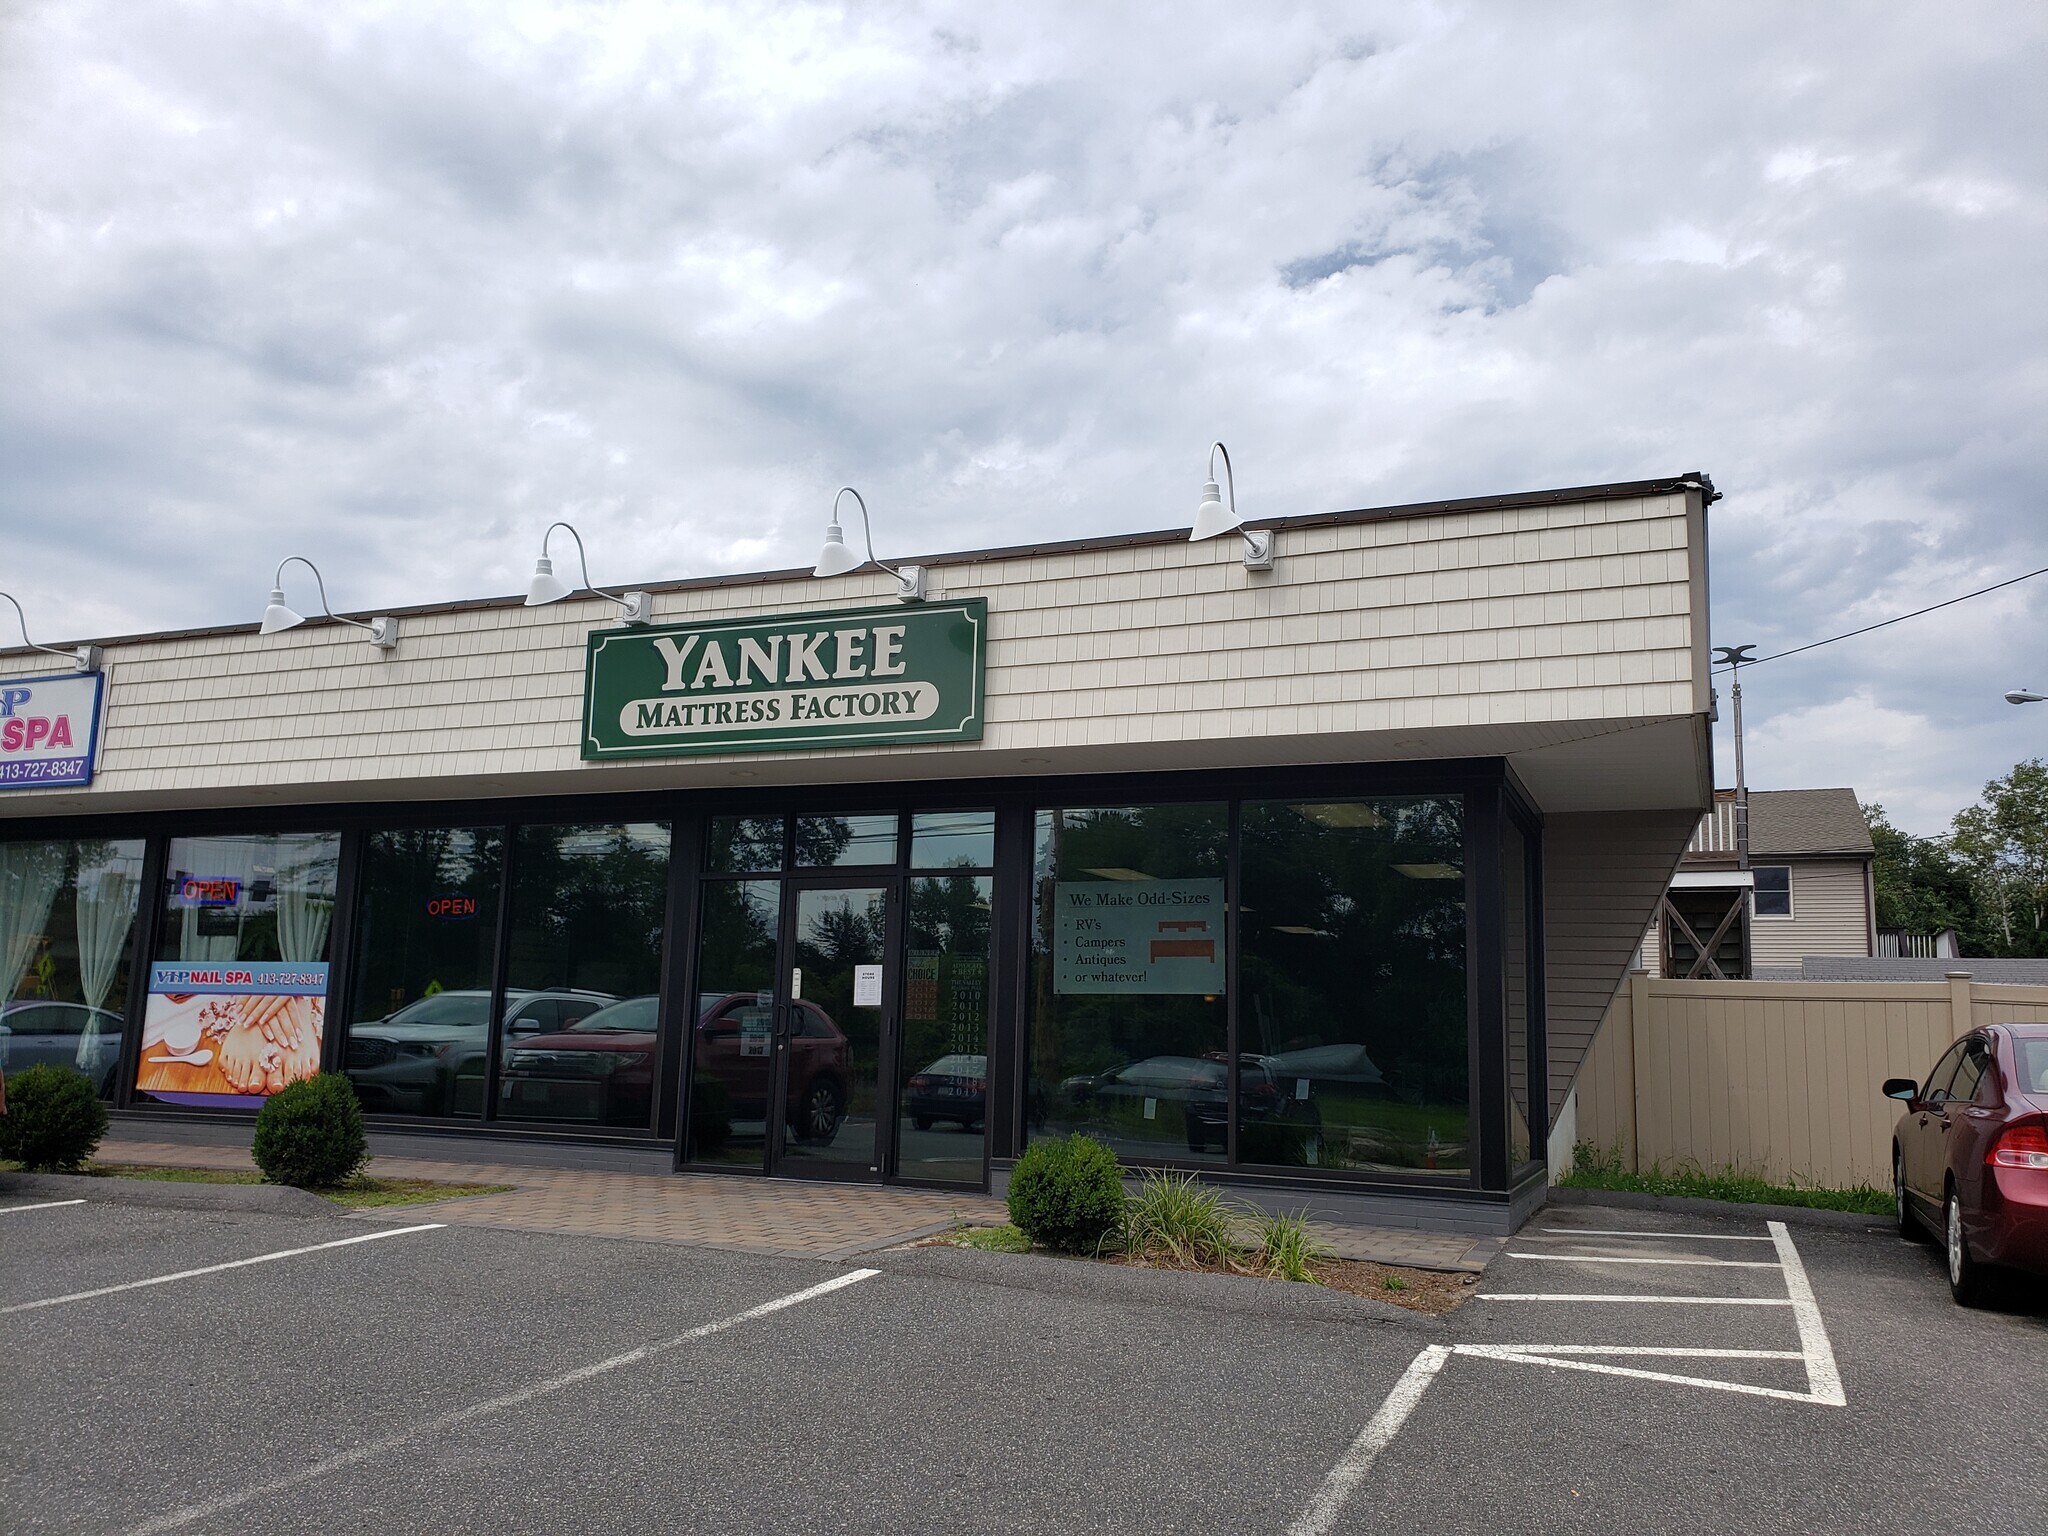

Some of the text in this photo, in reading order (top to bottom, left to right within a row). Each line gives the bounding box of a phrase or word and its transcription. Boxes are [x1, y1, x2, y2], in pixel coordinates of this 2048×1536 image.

[653, 625, 907, 691] YANKEE
[636, 690, 922, 729] MATTRESS FACTORY
[1, 714, 74, 752] SPA
[183, 880, 237, 900] OPEN
[1069, 891, 1210, 906] We Make Odd-Sizes
[427, 898, 476, 916] OPEN
[1075, 919, 1102, 930] RV's
[1075, 936, 1126, 949] Campers
[1074, 953, 1127, 967] Antiques
[157, 970, 325, 985] VIP NAIL SPA 413-727-8347
[908, 968, 936, 980] CHOICE
[1075, 970, 1147, 982] or whatever!
[952, 991, 981, 1000] 2010
[952, 1002, 980, 1010] 2011
[951, 1012, 980, 1021] 2012
[951, 1023, 979, 1032] 2013
[950, 1034, 978, 1042] 2014
[950, 1044, 978, 1054] 2015
[949, 1066, 978, 1074] 2017
[949, 1076, 978, 1086] 2018
[948, 1087, 977, 1097] 2019
